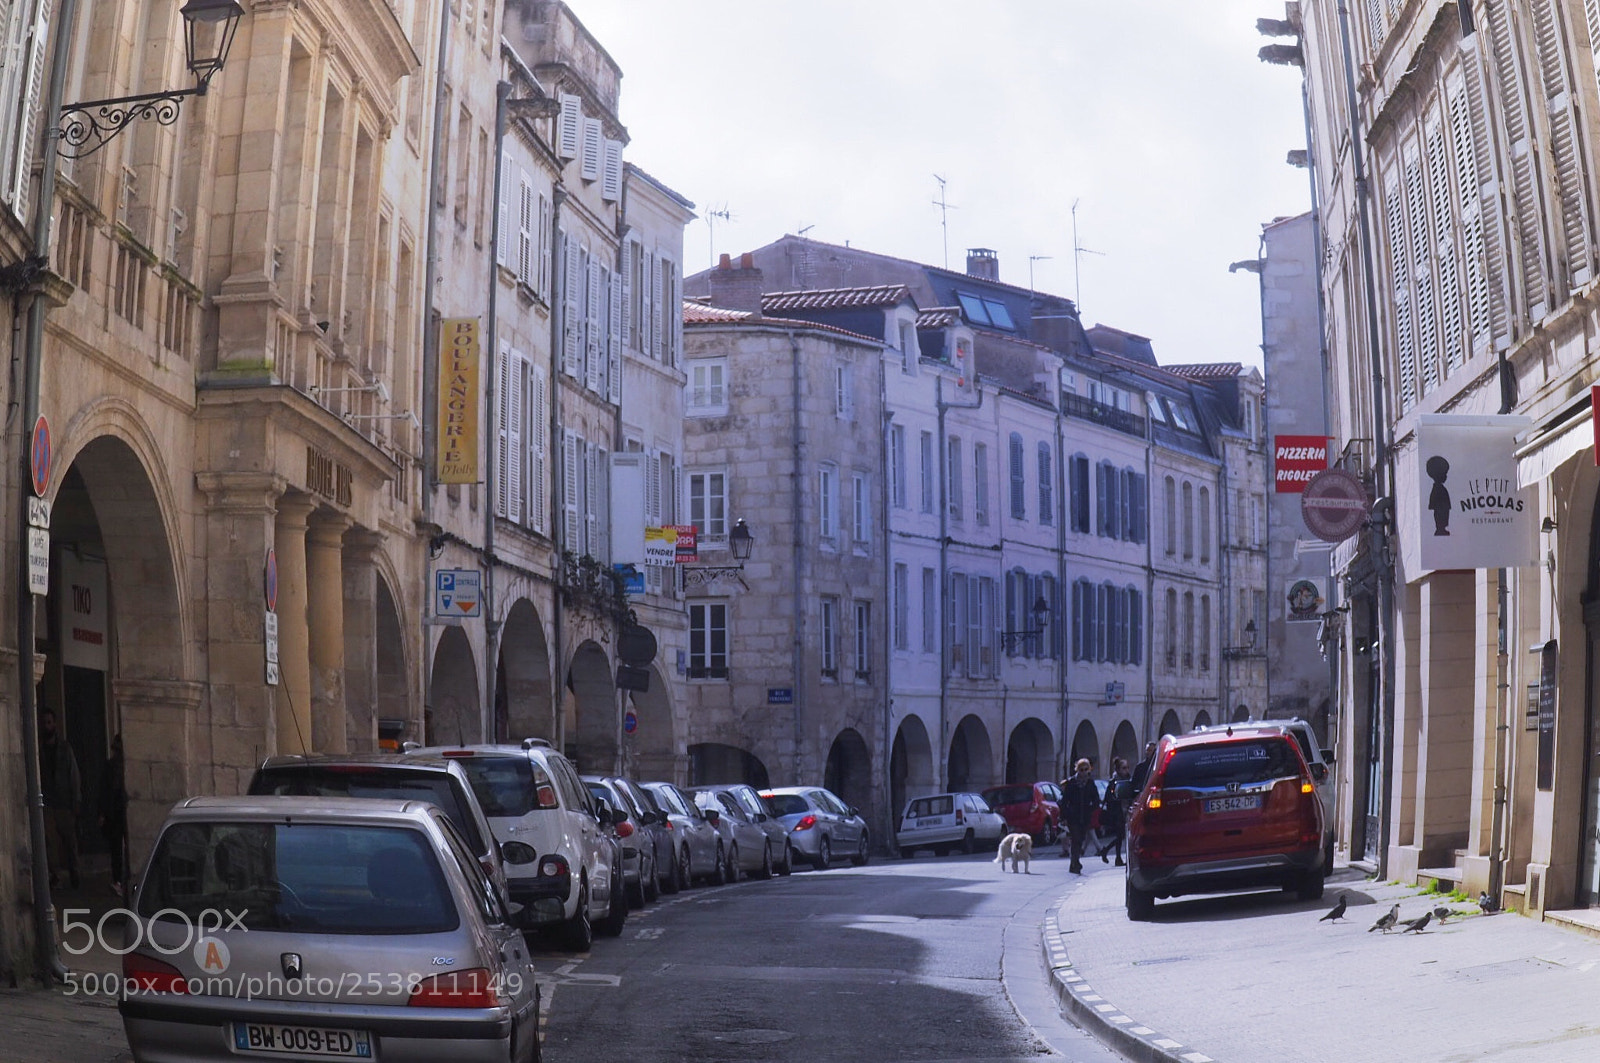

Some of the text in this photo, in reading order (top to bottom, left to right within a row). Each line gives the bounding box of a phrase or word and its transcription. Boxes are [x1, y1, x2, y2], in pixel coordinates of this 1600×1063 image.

[444, 322, 473, 463] BOULANGERIE
[1276, 446, 1326, 460] PIZZERIA
[1469, 477, 1510, 495] LE P'TIT
[1460, 495, 1524, 512] NICOLAS
[646, 547, 674, 557] VENDRE
[440, 574, 452, 590] P
[204, 942, 224, 970] A
[432, 956, 455, 966] 106
